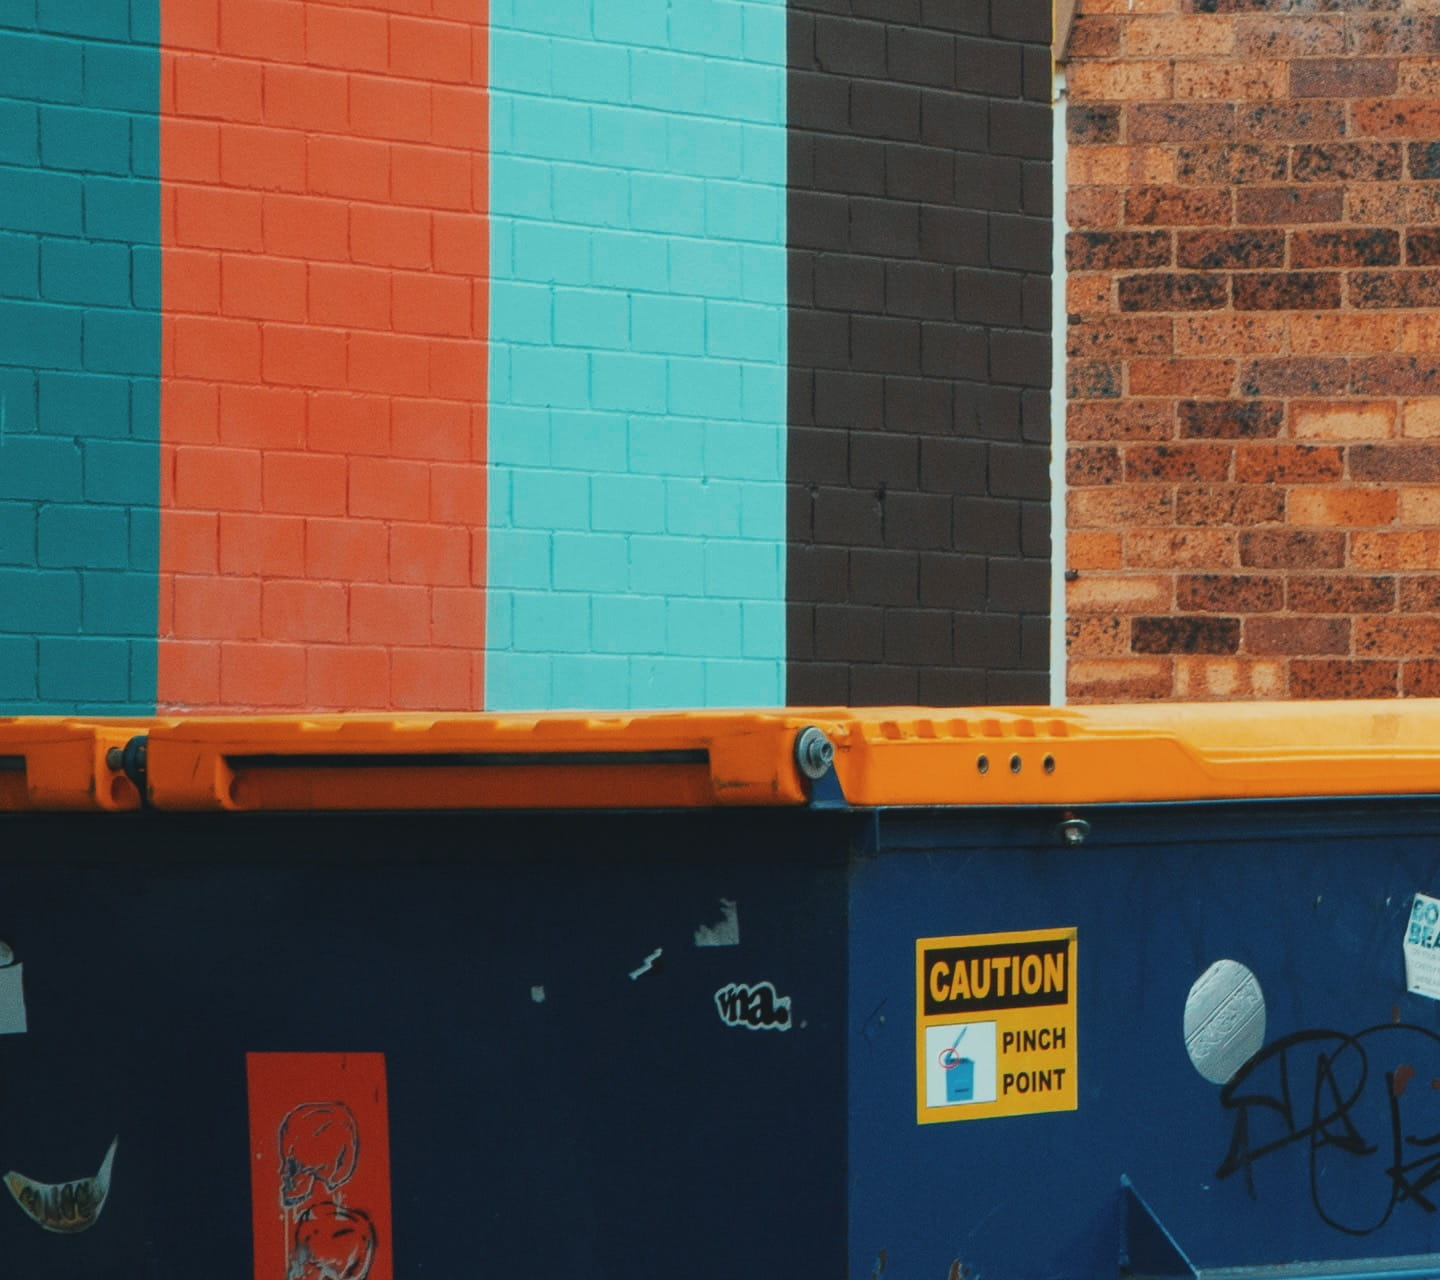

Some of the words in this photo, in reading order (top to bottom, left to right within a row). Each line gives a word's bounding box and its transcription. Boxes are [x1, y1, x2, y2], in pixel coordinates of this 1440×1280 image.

[929, 953, 1066, 1003] CAUTION
[1002, 1028, 1067, 1055] PINCH
[1002, 1068, 1066, 1095] POINT
